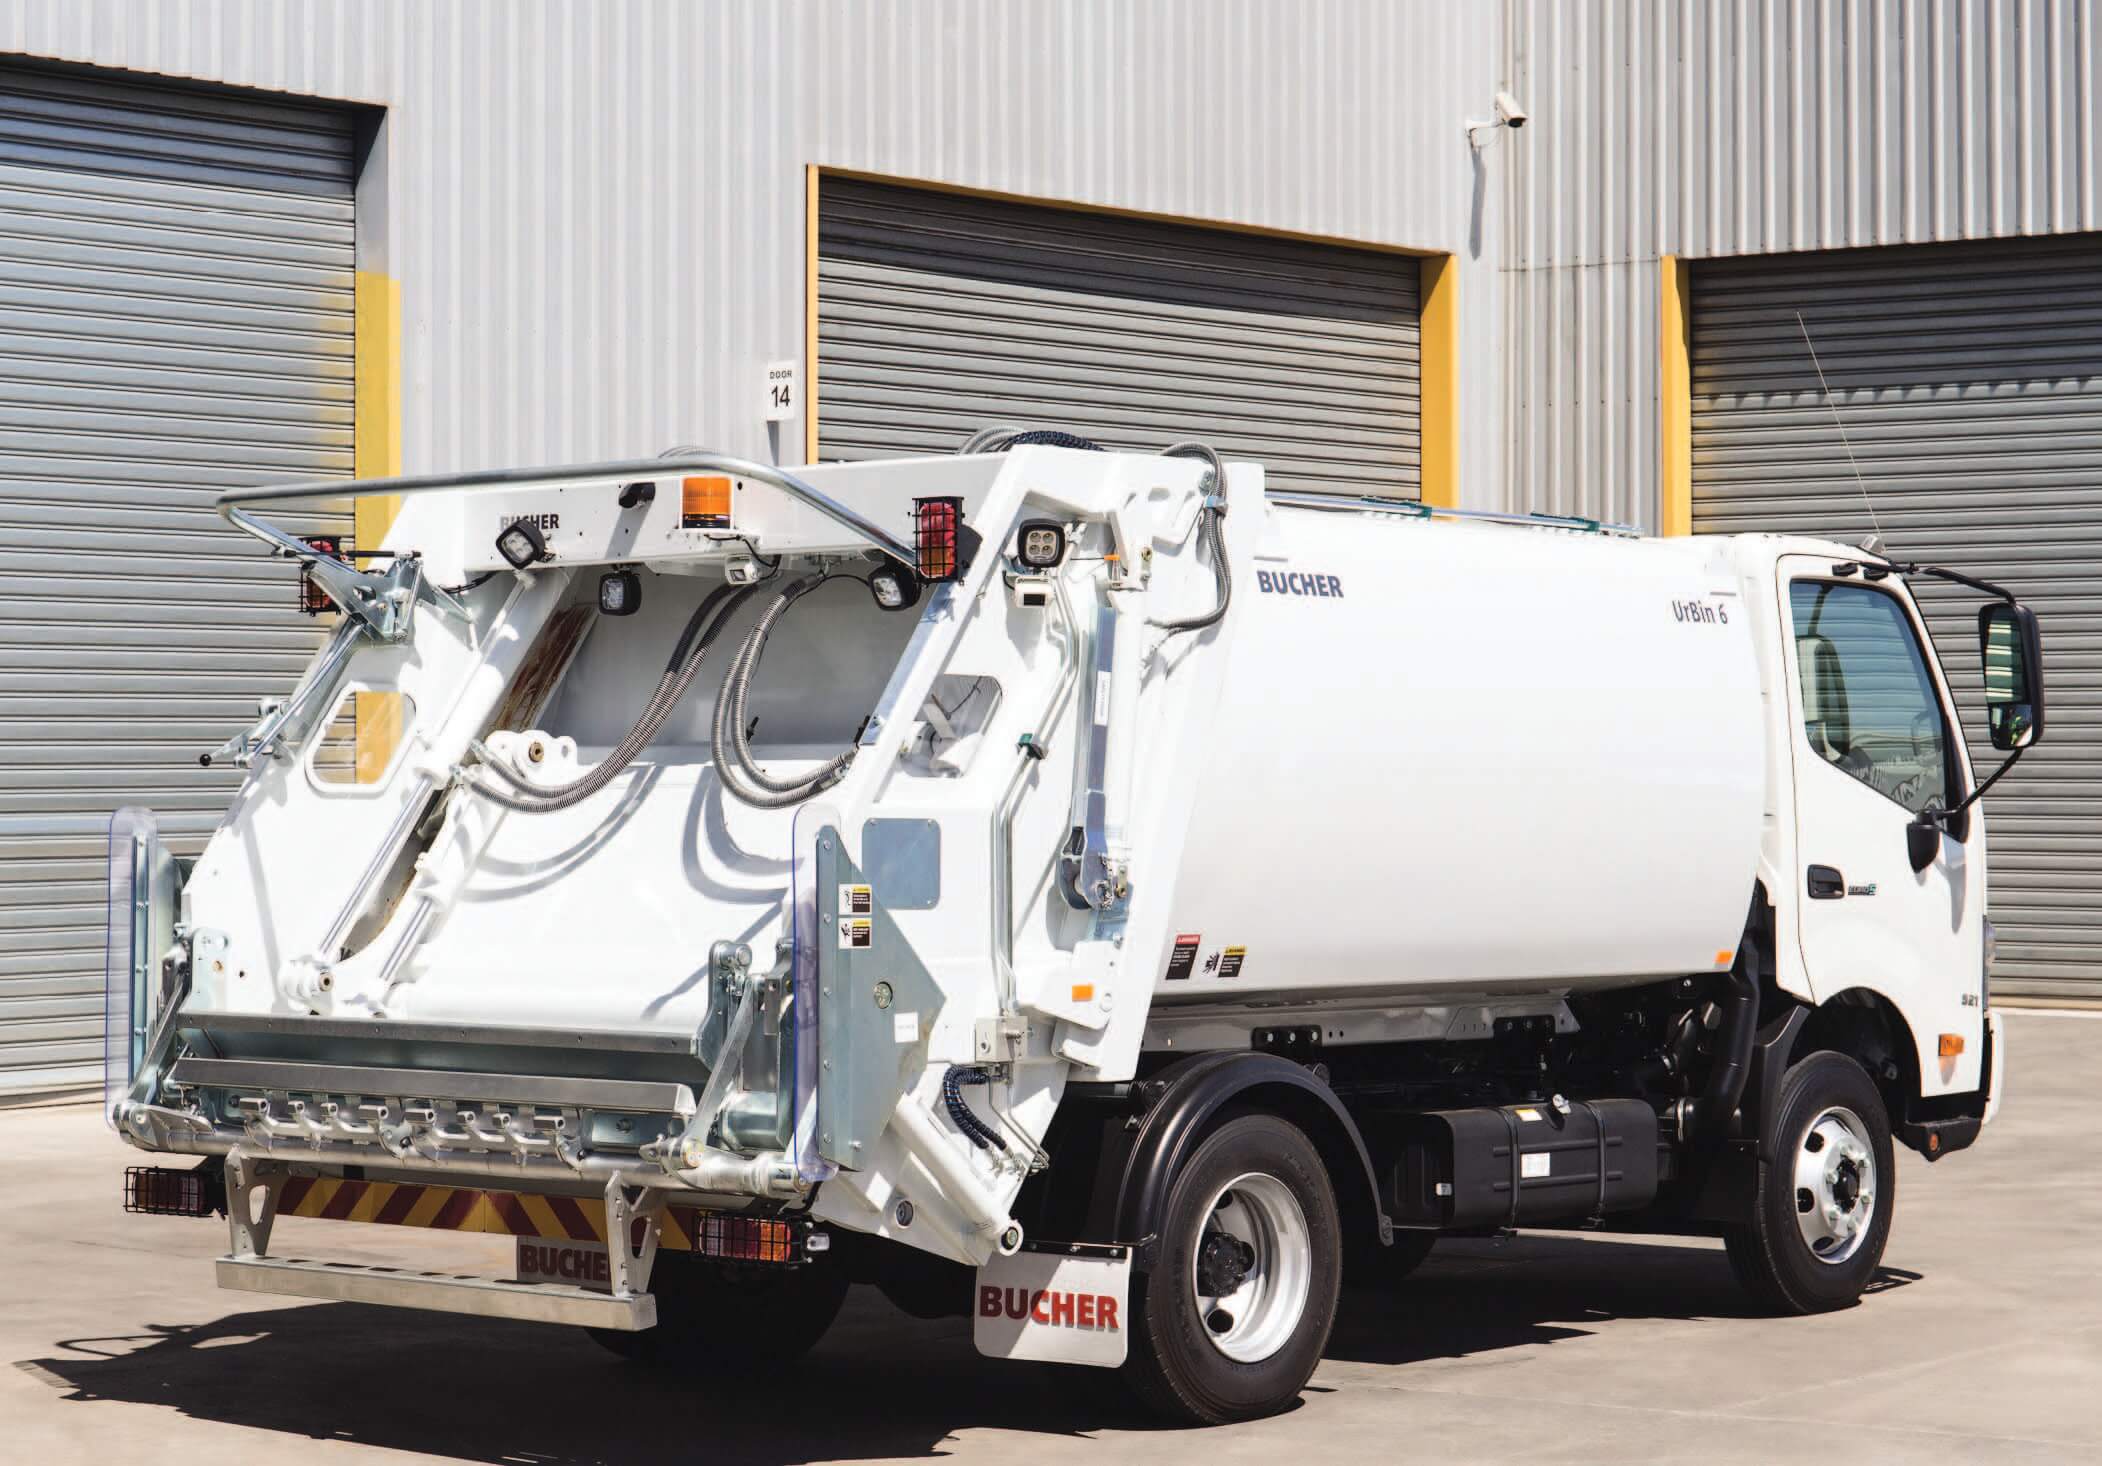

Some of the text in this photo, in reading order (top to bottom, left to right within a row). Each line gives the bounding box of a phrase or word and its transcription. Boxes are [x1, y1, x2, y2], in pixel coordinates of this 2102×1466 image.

[769, 370, 792, 379] DOOR
[771, 385, 790, 407] 14
[500, 514, 559, 531] BHER
[1256, 570, 1344, 598] BUCHER
[1672, 599, 1728, 625] UrBin 6
[520, 1244, 612, 1281] BUCHE
[980, 1285, 1119, 1330] BUCHER
